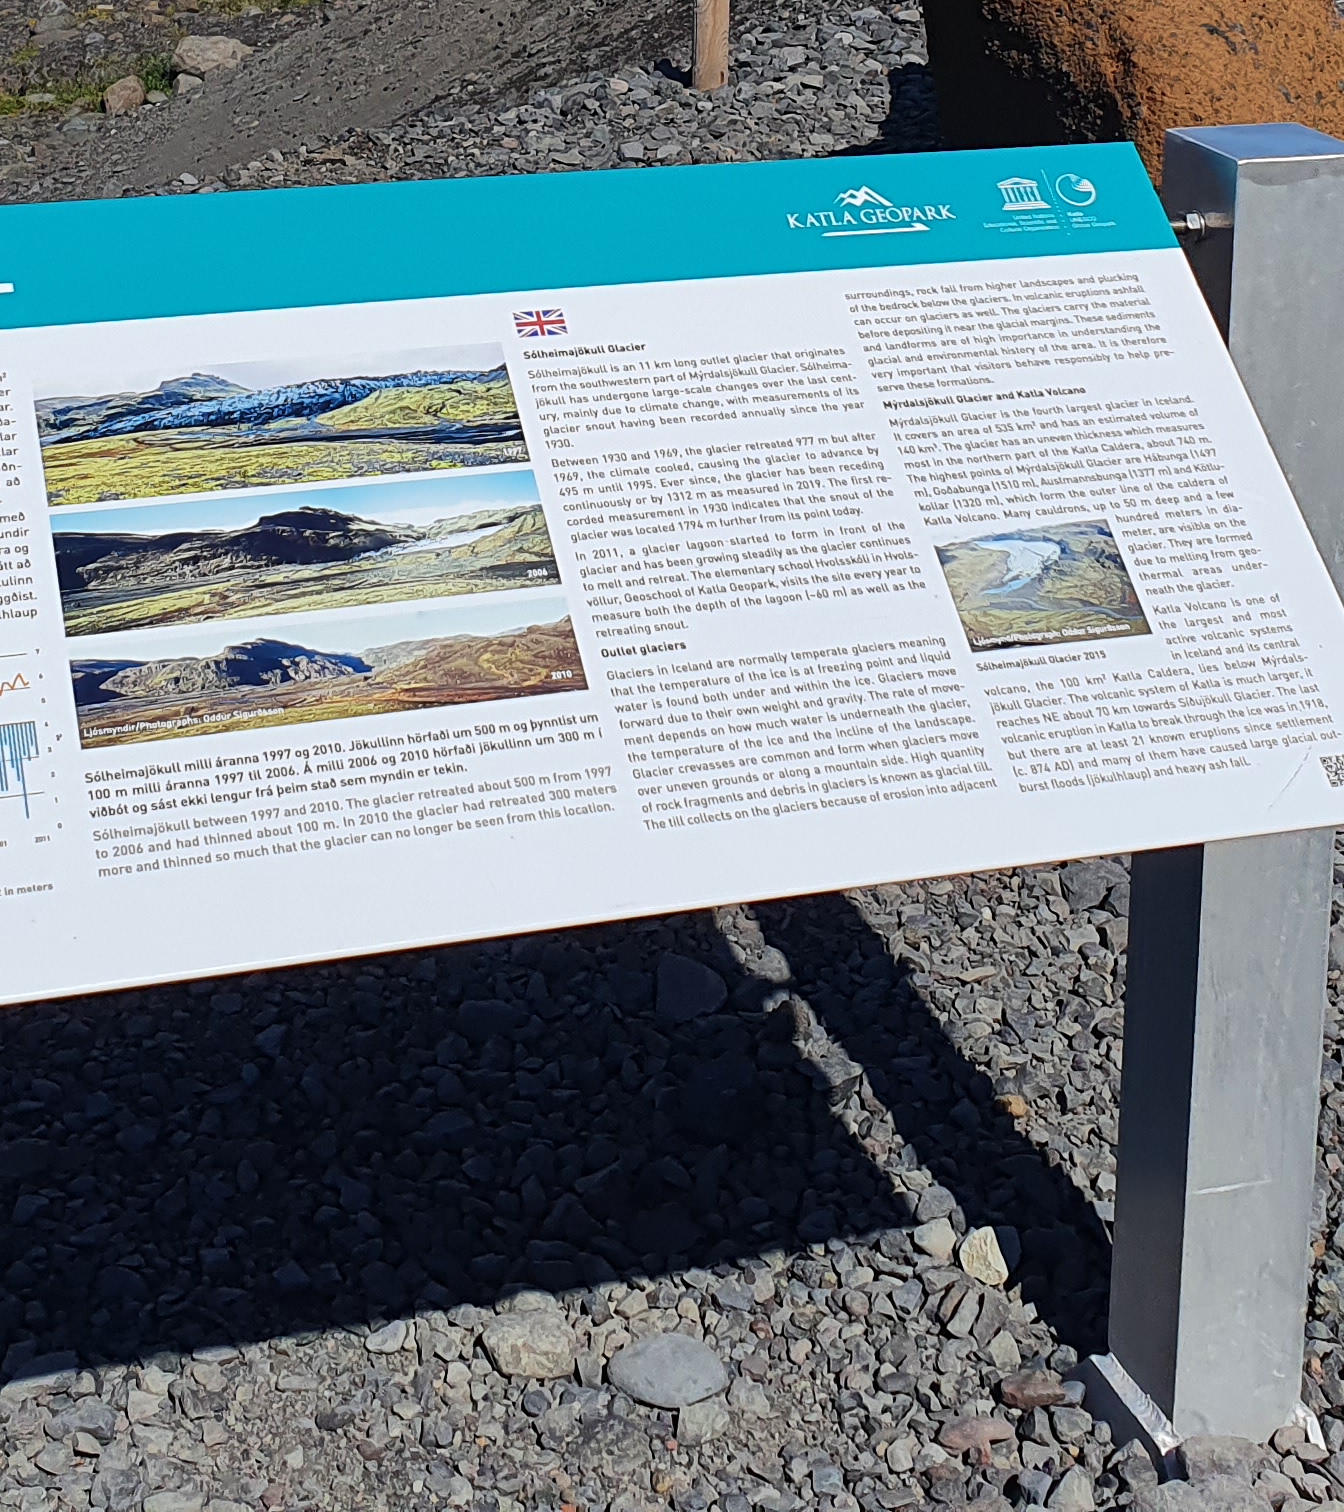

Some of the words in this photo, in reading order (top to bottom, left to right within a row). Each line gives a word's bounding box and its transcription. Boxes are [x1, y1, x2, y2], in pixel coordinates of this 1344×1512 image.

[786, 210, 858, 229] KATLA
[860, 204, 957, 225] GEOPARK
[523, 345, 606, 360] Sólheimajökull
[607, 342, 646, 353] Glacier
[882, 395, 956, 411] Mýrdalsjökull
[955, 393, 993, 404] Glacier
[995, 391, 1016, 401] and
[1015, 389, 1045, 399] Katla
[1044, 387, 1087, 397] Volcano
[566, 513, 605, 527] corded
[608, 507, 686, 523] measurement
[687, 505, 700, 516] in
[702, 502, 729, 514] 1930
[730, 499, 781, 512] indicates
[782, 495, 806, 507] that
[807, 493, 827, 504] the
[829, 491, 860, 502] snout
[862, 488, 874, 499] of
[875, 487, 894, 498] the
[1114, 510, 1161, 524] hundred
[1164, 508, 1203, 519] meters
[1205, 505, 1219, 515] in
[1222, 503, 1244, 514] dia-
[527, 568, 549, 578] 2006
[600, 645, 638, 658] Outlet
[639, 641, 687, 657] glaciers
[975, 656, 1048, 672] Sólheimajökull
[1047, 653, 1082, 664] Glacier
[1082, 649, 1107, 661] 2015
[551, 668, 573, 679] 2010
[203, 713, 232, 724] Oddur
[84, 761, 182, 784] Sólheimajökull
[184, 757, 213, 772] milli
[215, 754, 260, 768] áranna
[262, 748, 292, 762] 1997
[294, 748, 310, 760] og
[312, 742, 346, 756] 2010.
[348, 736, 405, 752] Jökullinn
[406, 728, 450, 745] hörfaði
[452, 729, 473, 739] um
[473, 723, 496, 736] 500
[498, 724, 511, 734] m
[513, 722, 528, 734] og
[529, 714, 578, 733] þynntist
[579, 714, 599, 724] um
[1006, 749, 1028, 761] but
[1029, 747, 1061, 758] there
[1063, 744, 1083, 754] are
[1085, 741, 1099, 752] at
[1099, 737, 1129, 750] least
[1130, 735, 1145, 747] 21
[1148, 733, 1186, 744] known
[1188, 725, 1241, 741] eruptions
[1243, 722, 1273, 734] since
[1275, 714, 1334, 730] settlement
[632, 765, 675, 780] Glacier
[677, 759, 736, 774] crevasses
[738, 756, 758, 767] are
[760, 750, 811, 764] common
[813, 745, 836, 758] and
[837, 743, 866, 755] form
[867, 740, 900, 752] when
[901, 733, 947, 750] glaciers
[948, 731, 980, 742] move
[92, 818, 191, 842] Sólheimajökull
[192, 814, 248, 829] between
[250, 807, 280, 822] 1997
[283, 803, 307, 818] and
[309, 799, 344, 814] 2010.
[344, 797, 370, 810] The
[372, 791, 415, 809] glacier
[417, 782, 475, 801] retreated
[477, 778, 513, 793] about
[513, 775, 536, 788] 500
[538, 776, 551, 786] m
[552, 772, 582, 784] from
[584, 765, 612, 780] 1997
